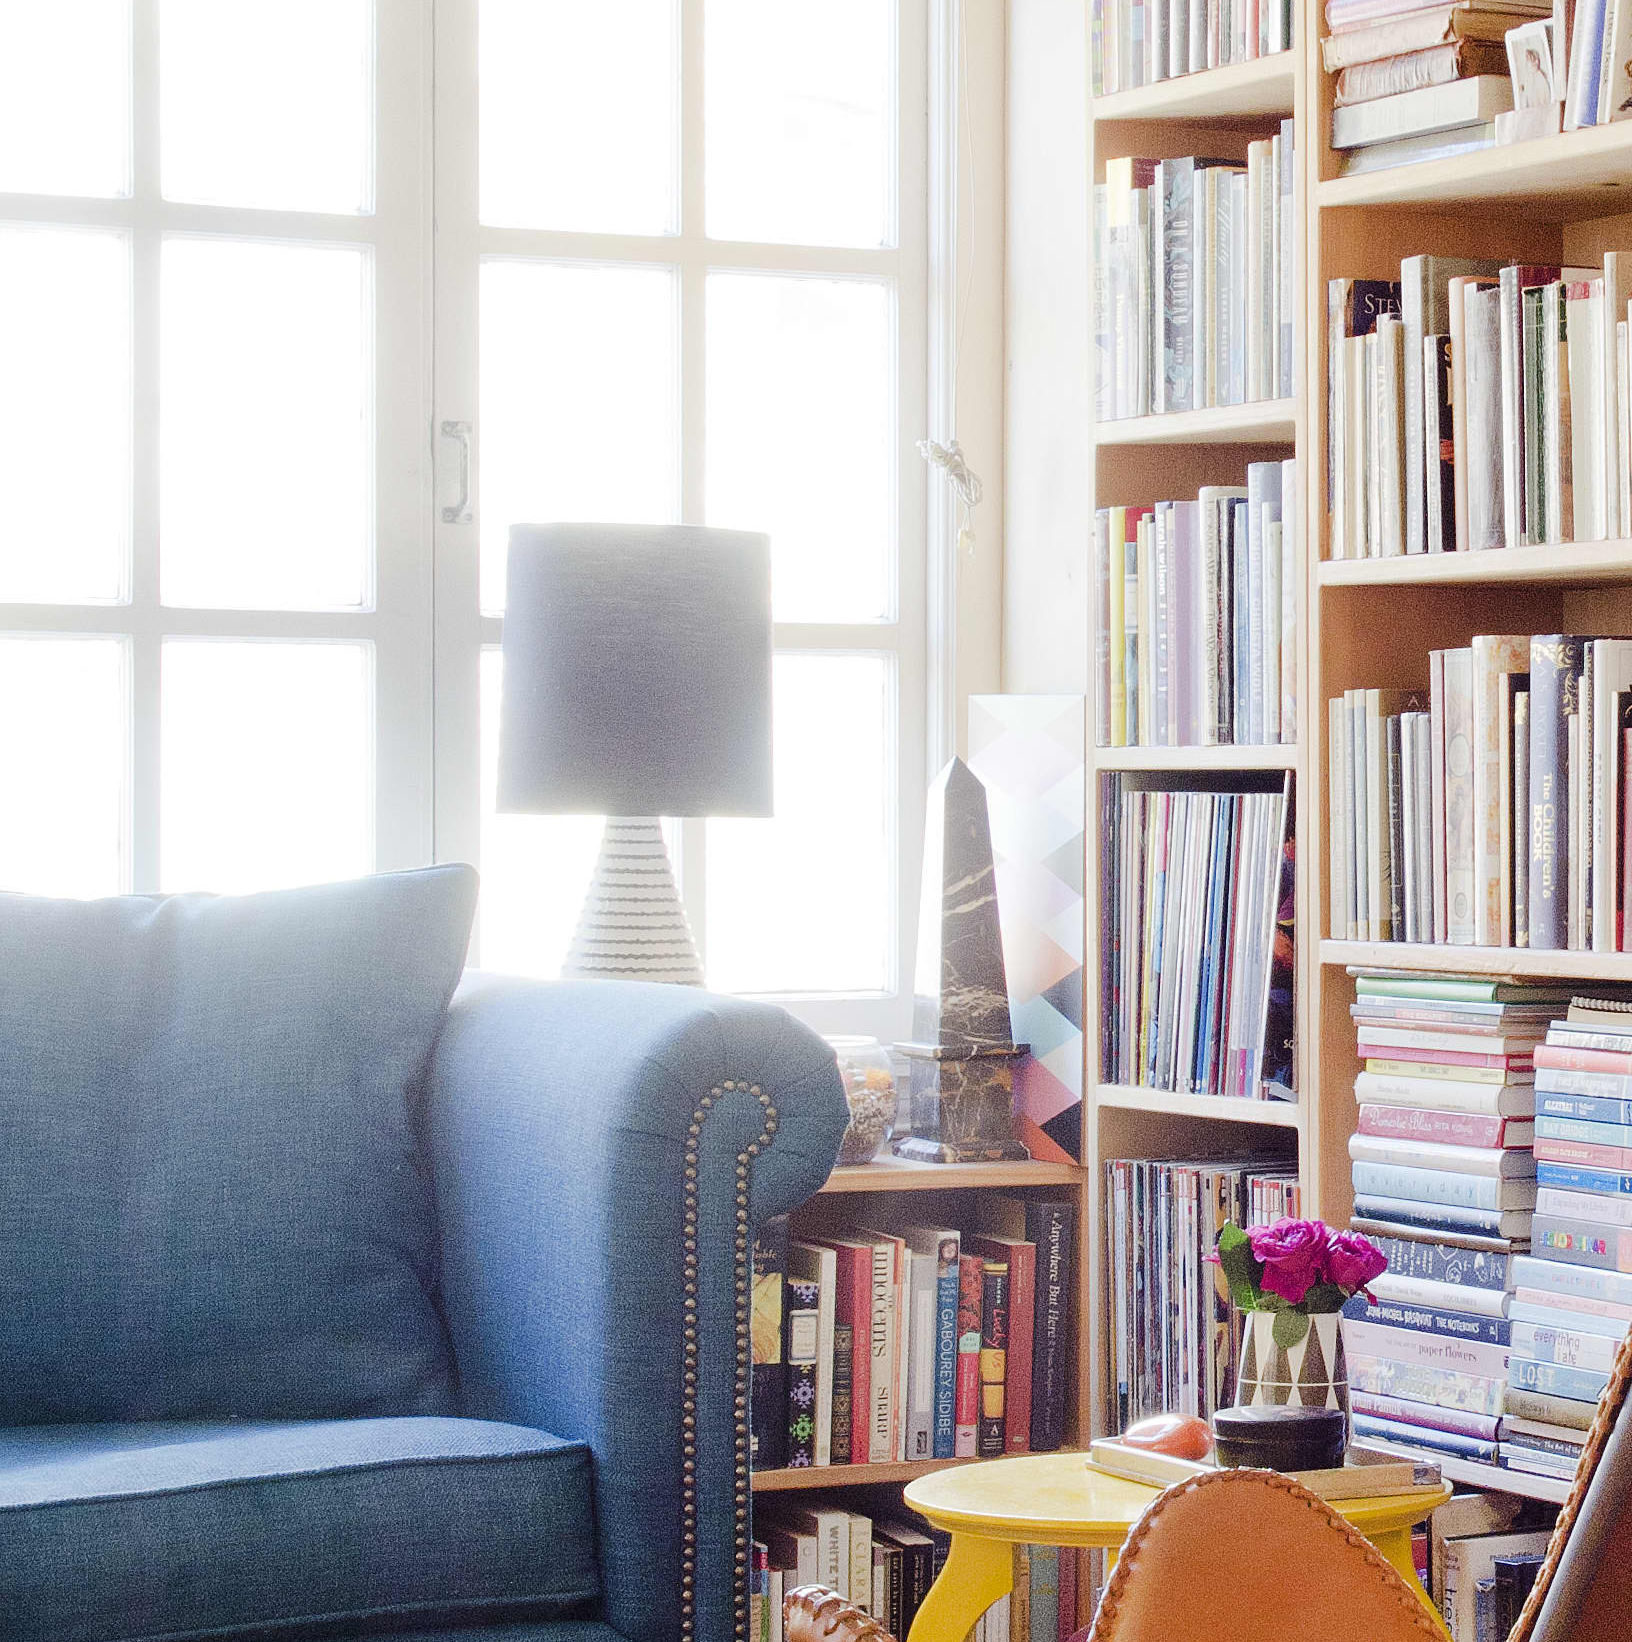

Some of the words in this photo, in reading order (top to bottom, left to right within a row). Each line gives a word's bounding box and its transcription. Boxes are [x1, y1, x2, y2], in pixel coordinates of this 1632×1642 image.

[1541, 774, 1553, 801] The
[1533, 803, 1544, 861] BOOK
[1540, 804, 1555, 900] Children's
[1050, 1218, 1061, 1281] Anywhere
[941, 1302, 953, 1387] GABOUREY
[1418, 1343, 1443, 1360] paper
[1533, 1328, 1580, 1351] everything
[1519, 1363, 1555, 1387] LOST
[939, 1388, 951, 1438] SIDIBE
[828, 1525, 840, 1569] WHITE
